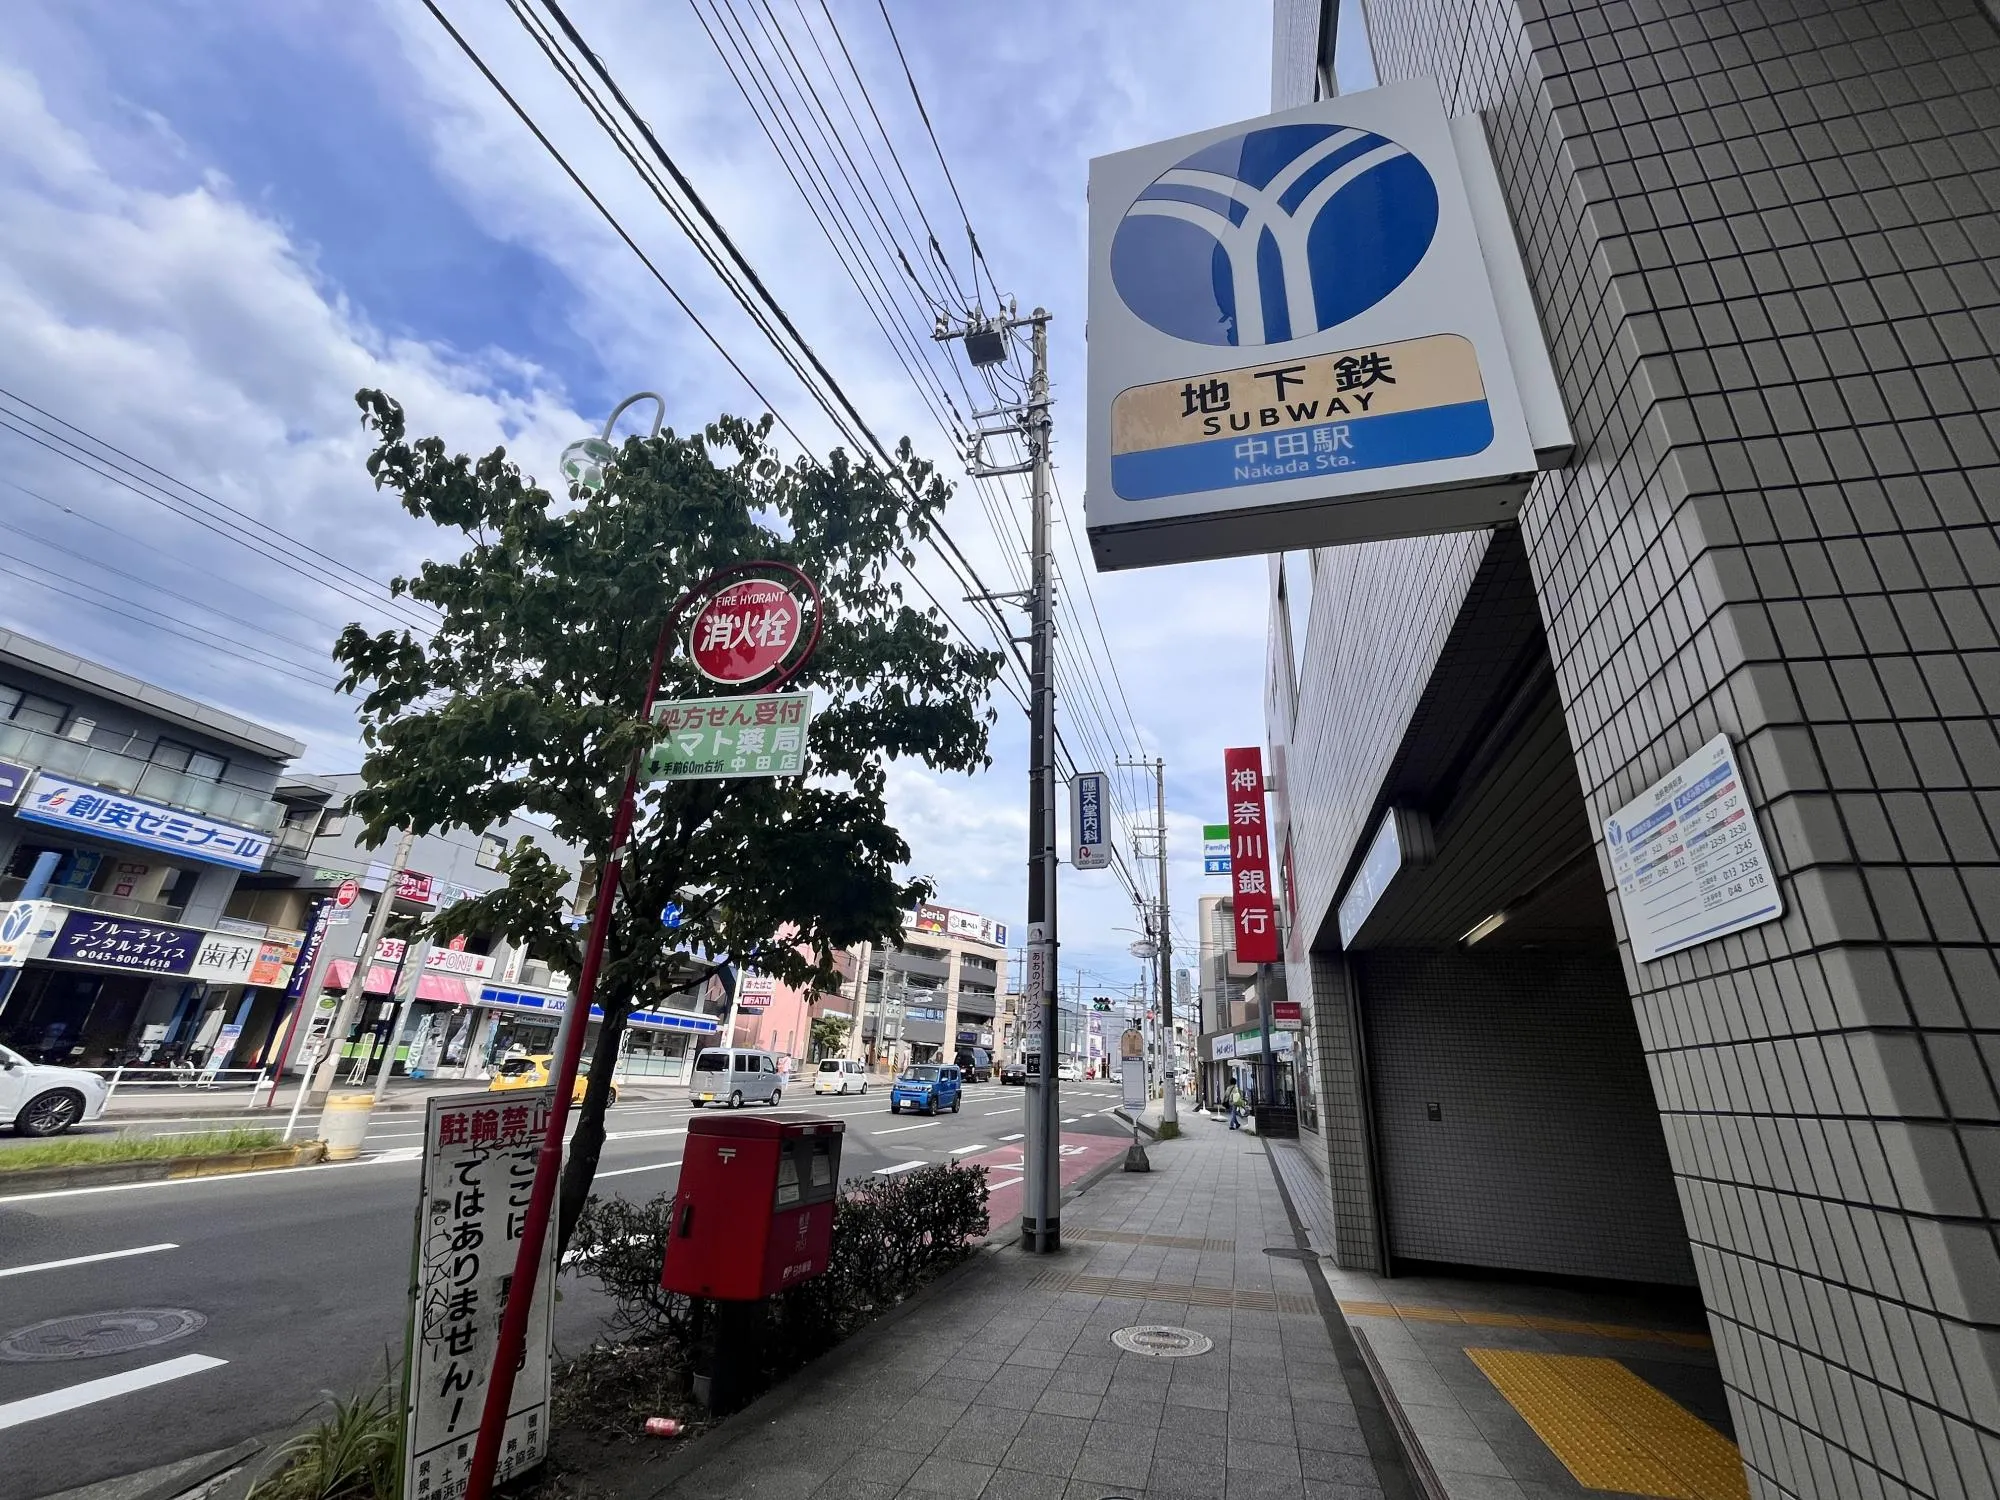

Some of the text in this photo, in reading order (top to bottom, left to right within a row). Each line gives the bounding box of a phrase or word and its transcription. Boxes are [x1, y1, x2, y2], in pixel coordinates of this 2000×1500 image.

[1180, 351, 1396, 418] 地下鉄
[1203, 391, 1375, 436] SUBWAY
[1234, 425, 1354, 464] 中田駅
[1234, 454, 1357, 481] Nakada Sta.
[715, 592, 785, 607] FIRE HYDRANT
[700, 608, 791, 651] 消火栓
[658, 700, 804, 731] 処方せん受付
[650, 727, 800, 758] トマト薬局
[663, 760, 724, 775] 手前60m右折
[731, 755, 799, 772] 中田店
[66, 794, 263, 857] 創英ゼミナール
[1231, 768, 1269, 935] 神奈川銀行
[1733, 838, 1753, 855] 23:45
[920, 908, 946, 921] Seria
[70, 933, 187, 959] デンタルオフィス
[90, 921, 181, 944] ブルーライン
[88, 950, 171, 969] 045-800-4618
[199, 942, 254, 971] 歯科
[439, 1104, 551, 1146] 駐輪禁止
[507, 1150, 539, 1241] ここは
[440, 1157, 485, 1434] ではありません!
